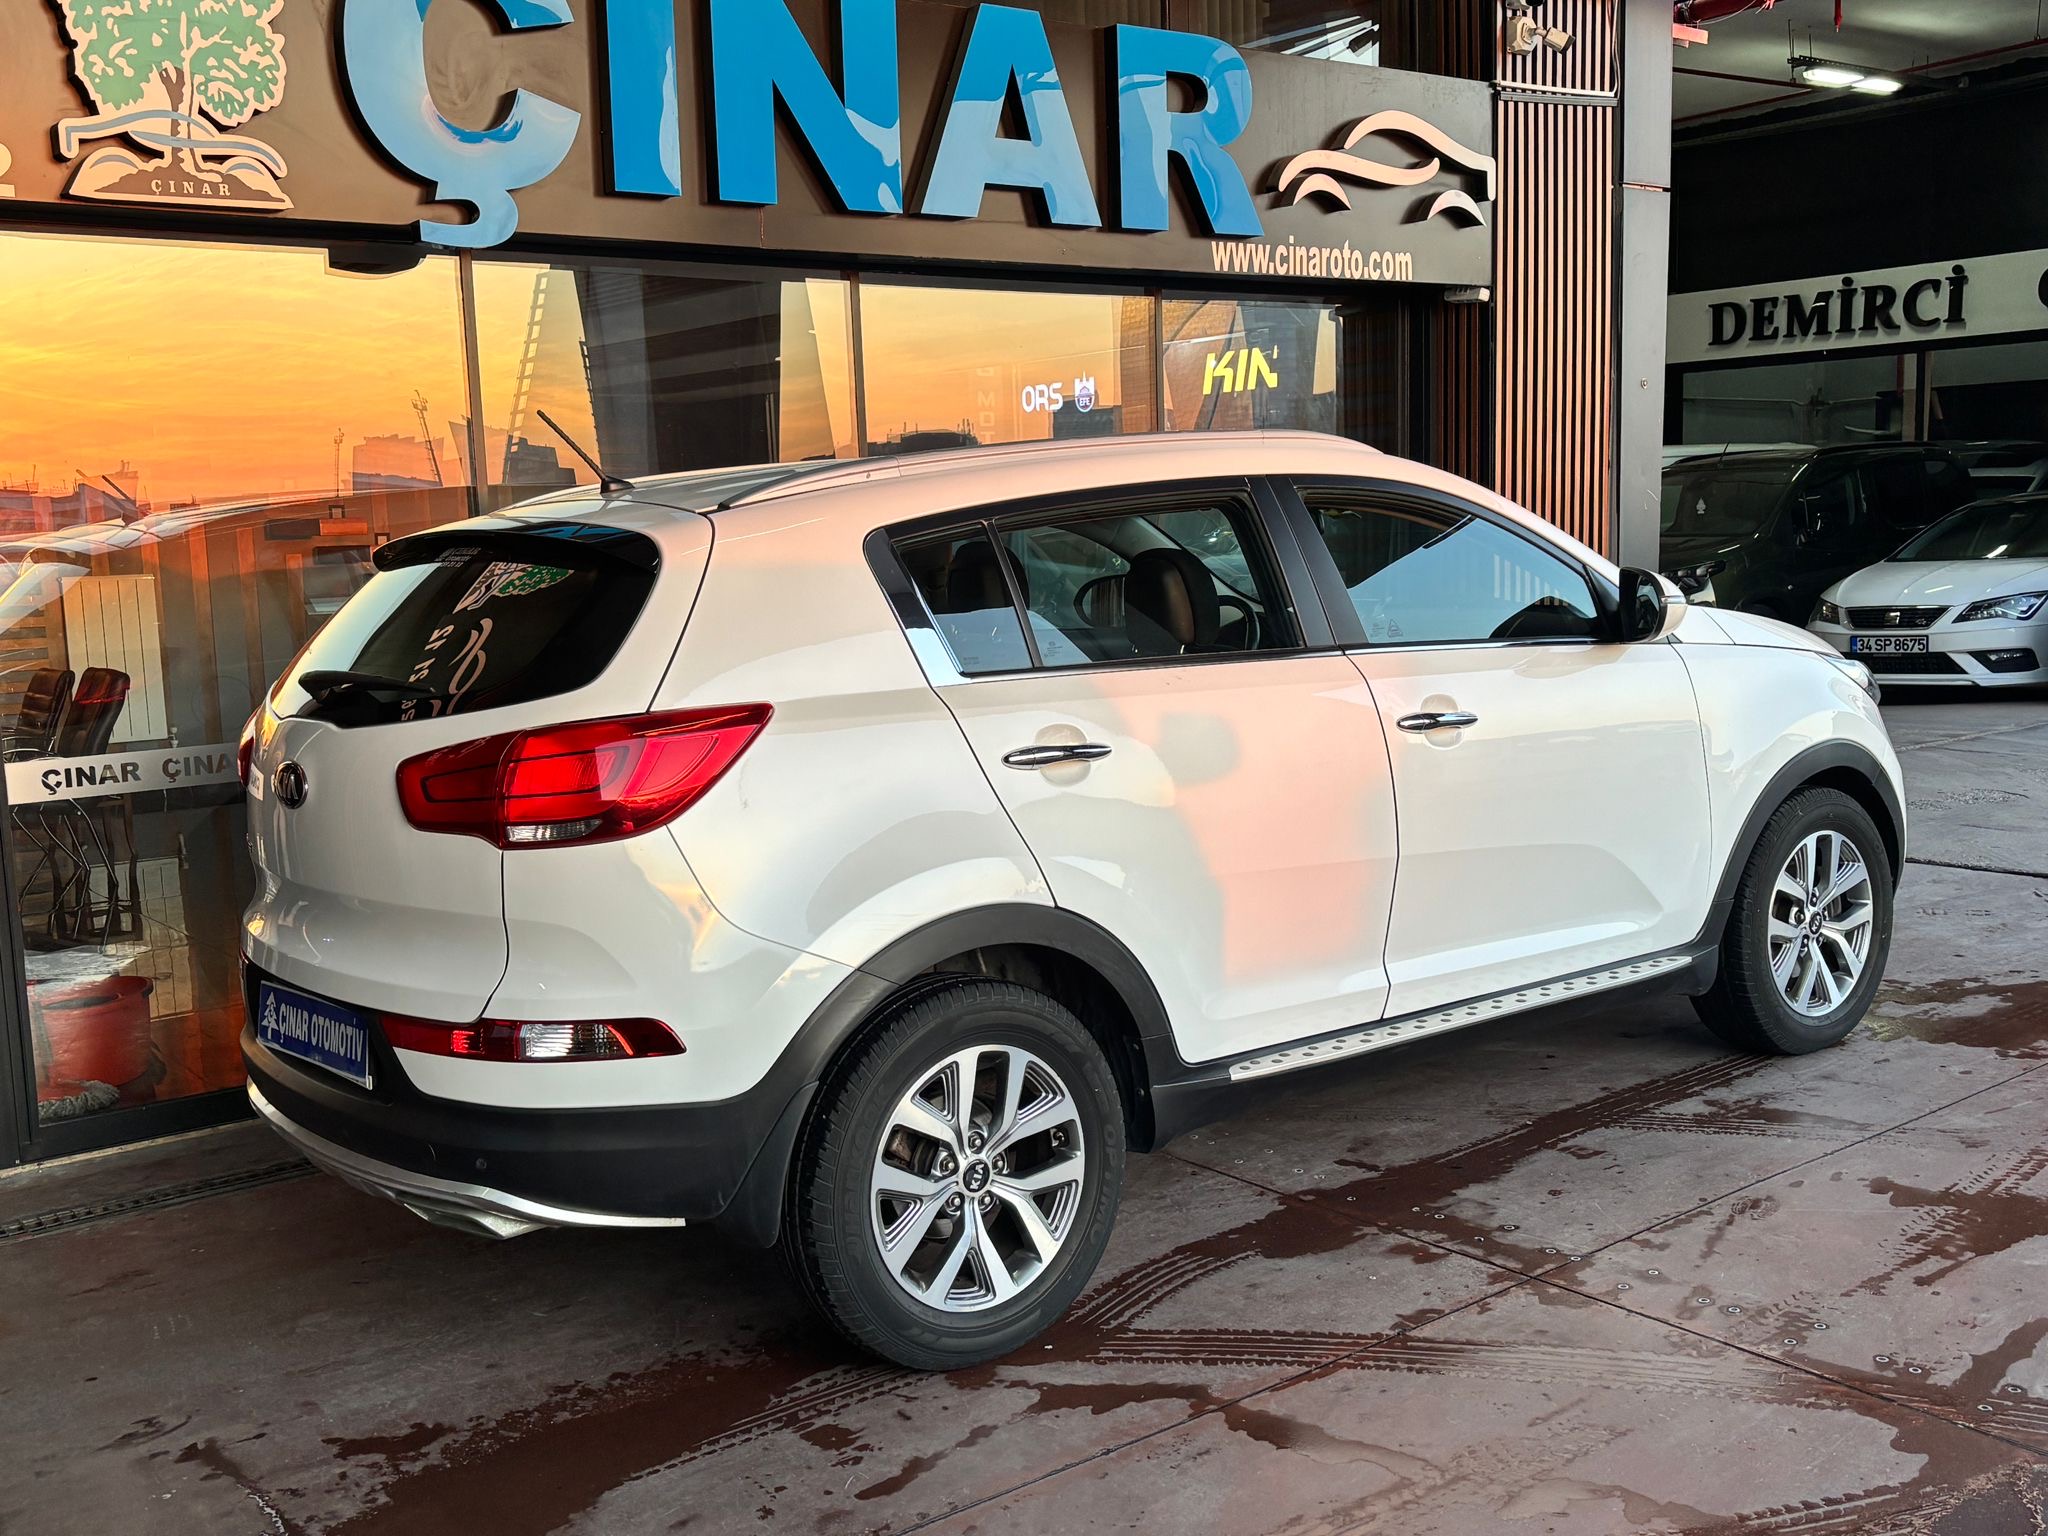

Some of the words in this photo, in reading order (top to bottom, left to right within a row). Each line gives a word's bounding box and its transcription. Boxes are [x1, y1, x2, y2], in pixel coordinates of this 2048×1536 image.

[340, 0, 1265, 249] ÇINAR
[151, 179, 231, 196] ÇINAR
[1211, 235, 1413, 281] www.cinaroto.com
[1706, 264, 1968, 346] DEMİRCİ
[1857, 638, 1872, 652] 34
[1875, 638, 1892, 652] SP
[1894, 638, 1926, 652] 8675
[41, 761, 141, 795] ÇINAR
[279, 1003, 309, 1043] ÇINAR
[310, 1013, 364, 1062] OTOMOTİV
[969, 1163, 985, 1190] KIA
